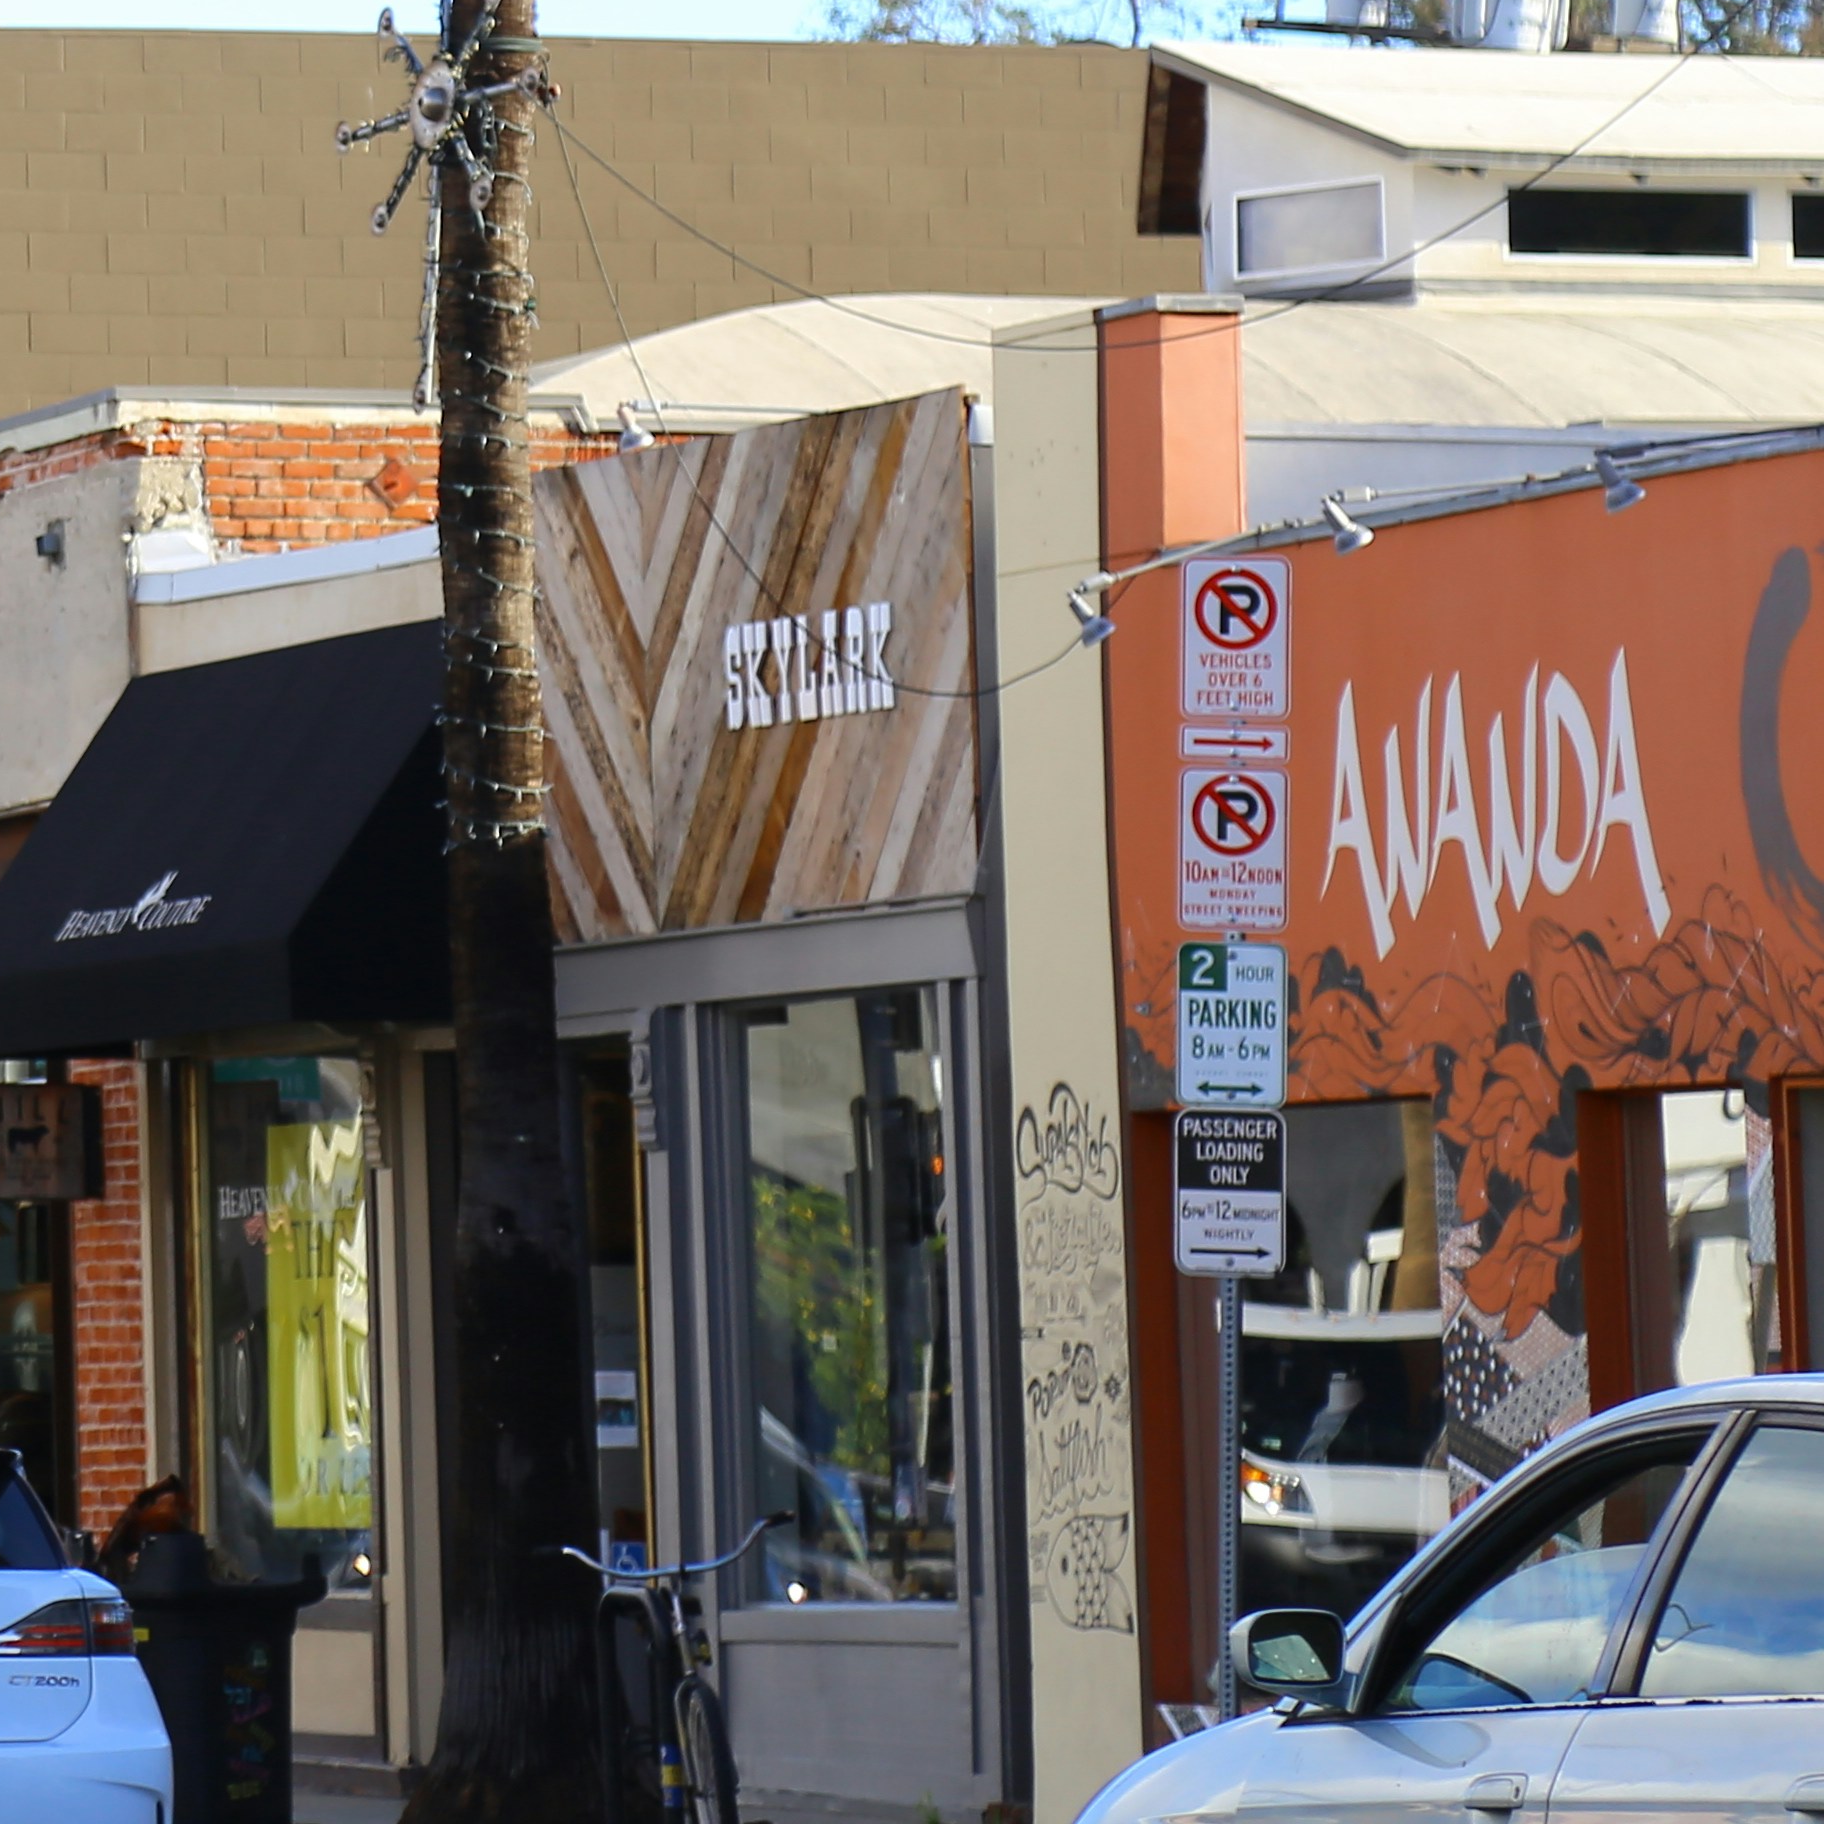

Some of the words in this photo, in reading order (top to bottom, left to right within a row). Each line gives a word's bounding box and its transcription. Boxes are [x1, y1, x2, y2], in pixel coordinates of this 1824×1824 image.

[723, 601, 896, 731] SKYLARK
[1199, 653, 1272, 670] VEHICLES
[1208, 672, 1247, 687] OVER
[1253, 672, 1263, 687] 6
[1196, 690, 1230, 706] FEET
[1238, 690, 1274, 707] HIGH
[1319, 644, 1672, 963] ANANDA
[1209, 888, 1257, 900] MONDAY
[1184, 904, 1222, 915] STREET
[1228, 905, 1283, 916] SWEEPING
[1192, 948, 1215, 987] 2
[1235, 965, 1275, 983] HOUR
[1188, 997, 1277, 1031] PARKING
[1182, 1118, 1278, 1141] PASSENGER
[1196, 1142, 1265, 1163] LOADING
[1209, 1165, 1250, 1185] ONLY
[1204, 1228, 1256, 1240] NIGHTLY
